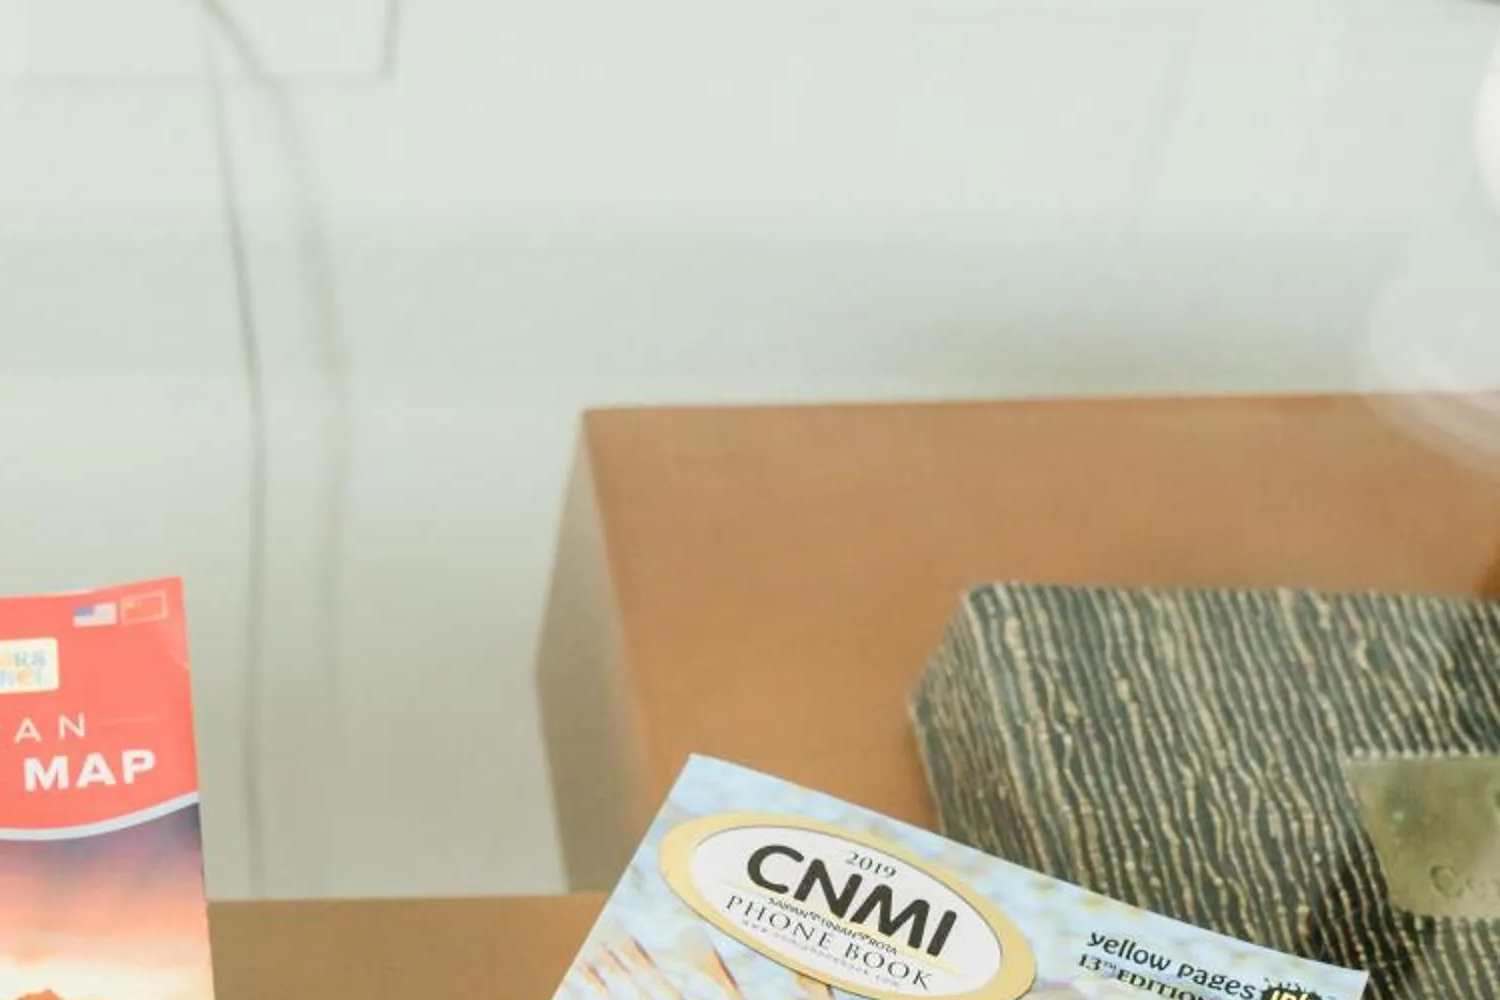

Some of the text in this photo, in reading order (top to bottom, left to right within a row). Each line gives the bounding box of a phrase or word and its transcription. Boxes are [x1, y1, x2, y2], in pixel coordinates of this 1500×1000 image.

[23, 749, 157, 792] MAP
[844, 850, 897, 880] 2019
[747, 844, 957, 958] CNMI
[725, 894, 832, 949] PHONE
[844, 942, 934, 991] BOOK
[1087, 931, 1255, 999] yellow pages
